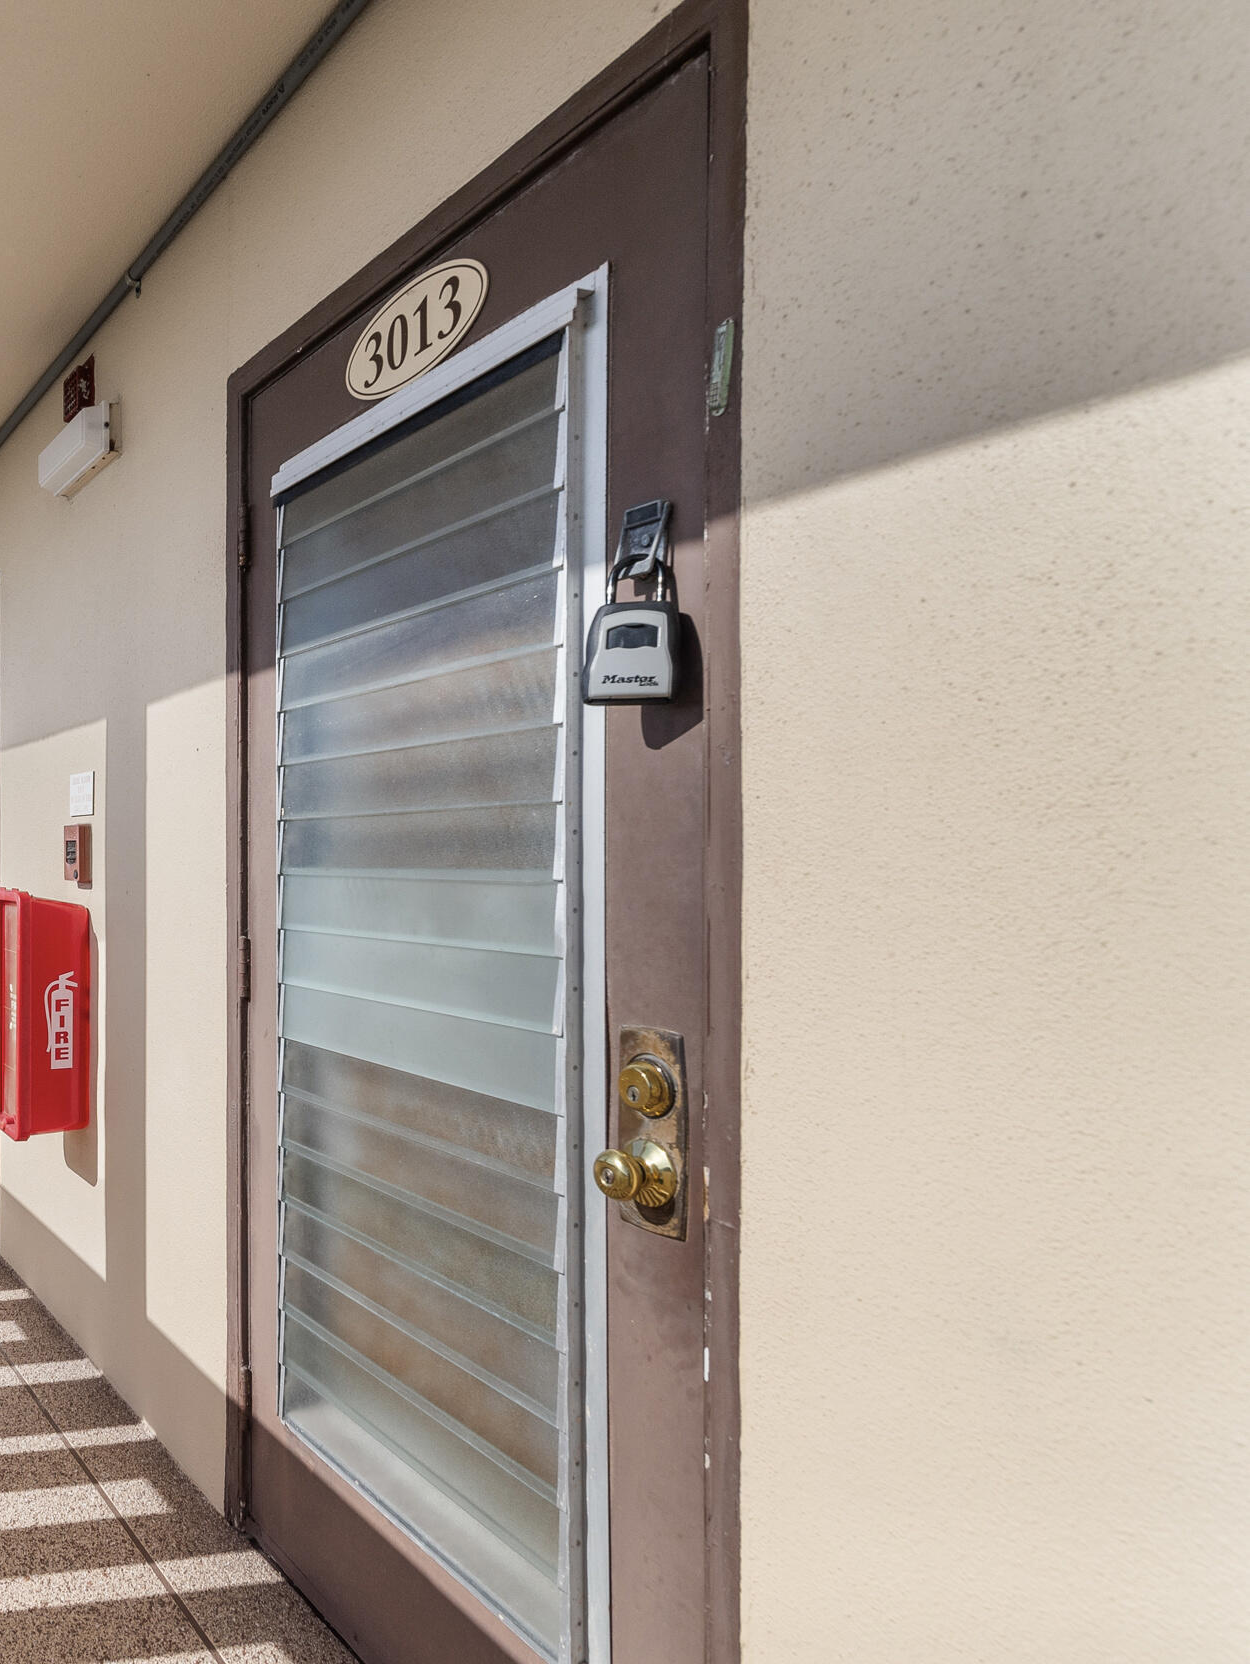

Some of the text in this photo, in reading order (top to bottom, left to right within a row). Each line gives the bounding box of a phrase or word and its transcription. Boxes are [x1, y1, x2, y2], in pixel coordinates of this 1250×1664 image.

[363, 275, 462, 389] 3013
[601, 674, 656, 684] Master
[55, 999, 70, 1060] FIRE
